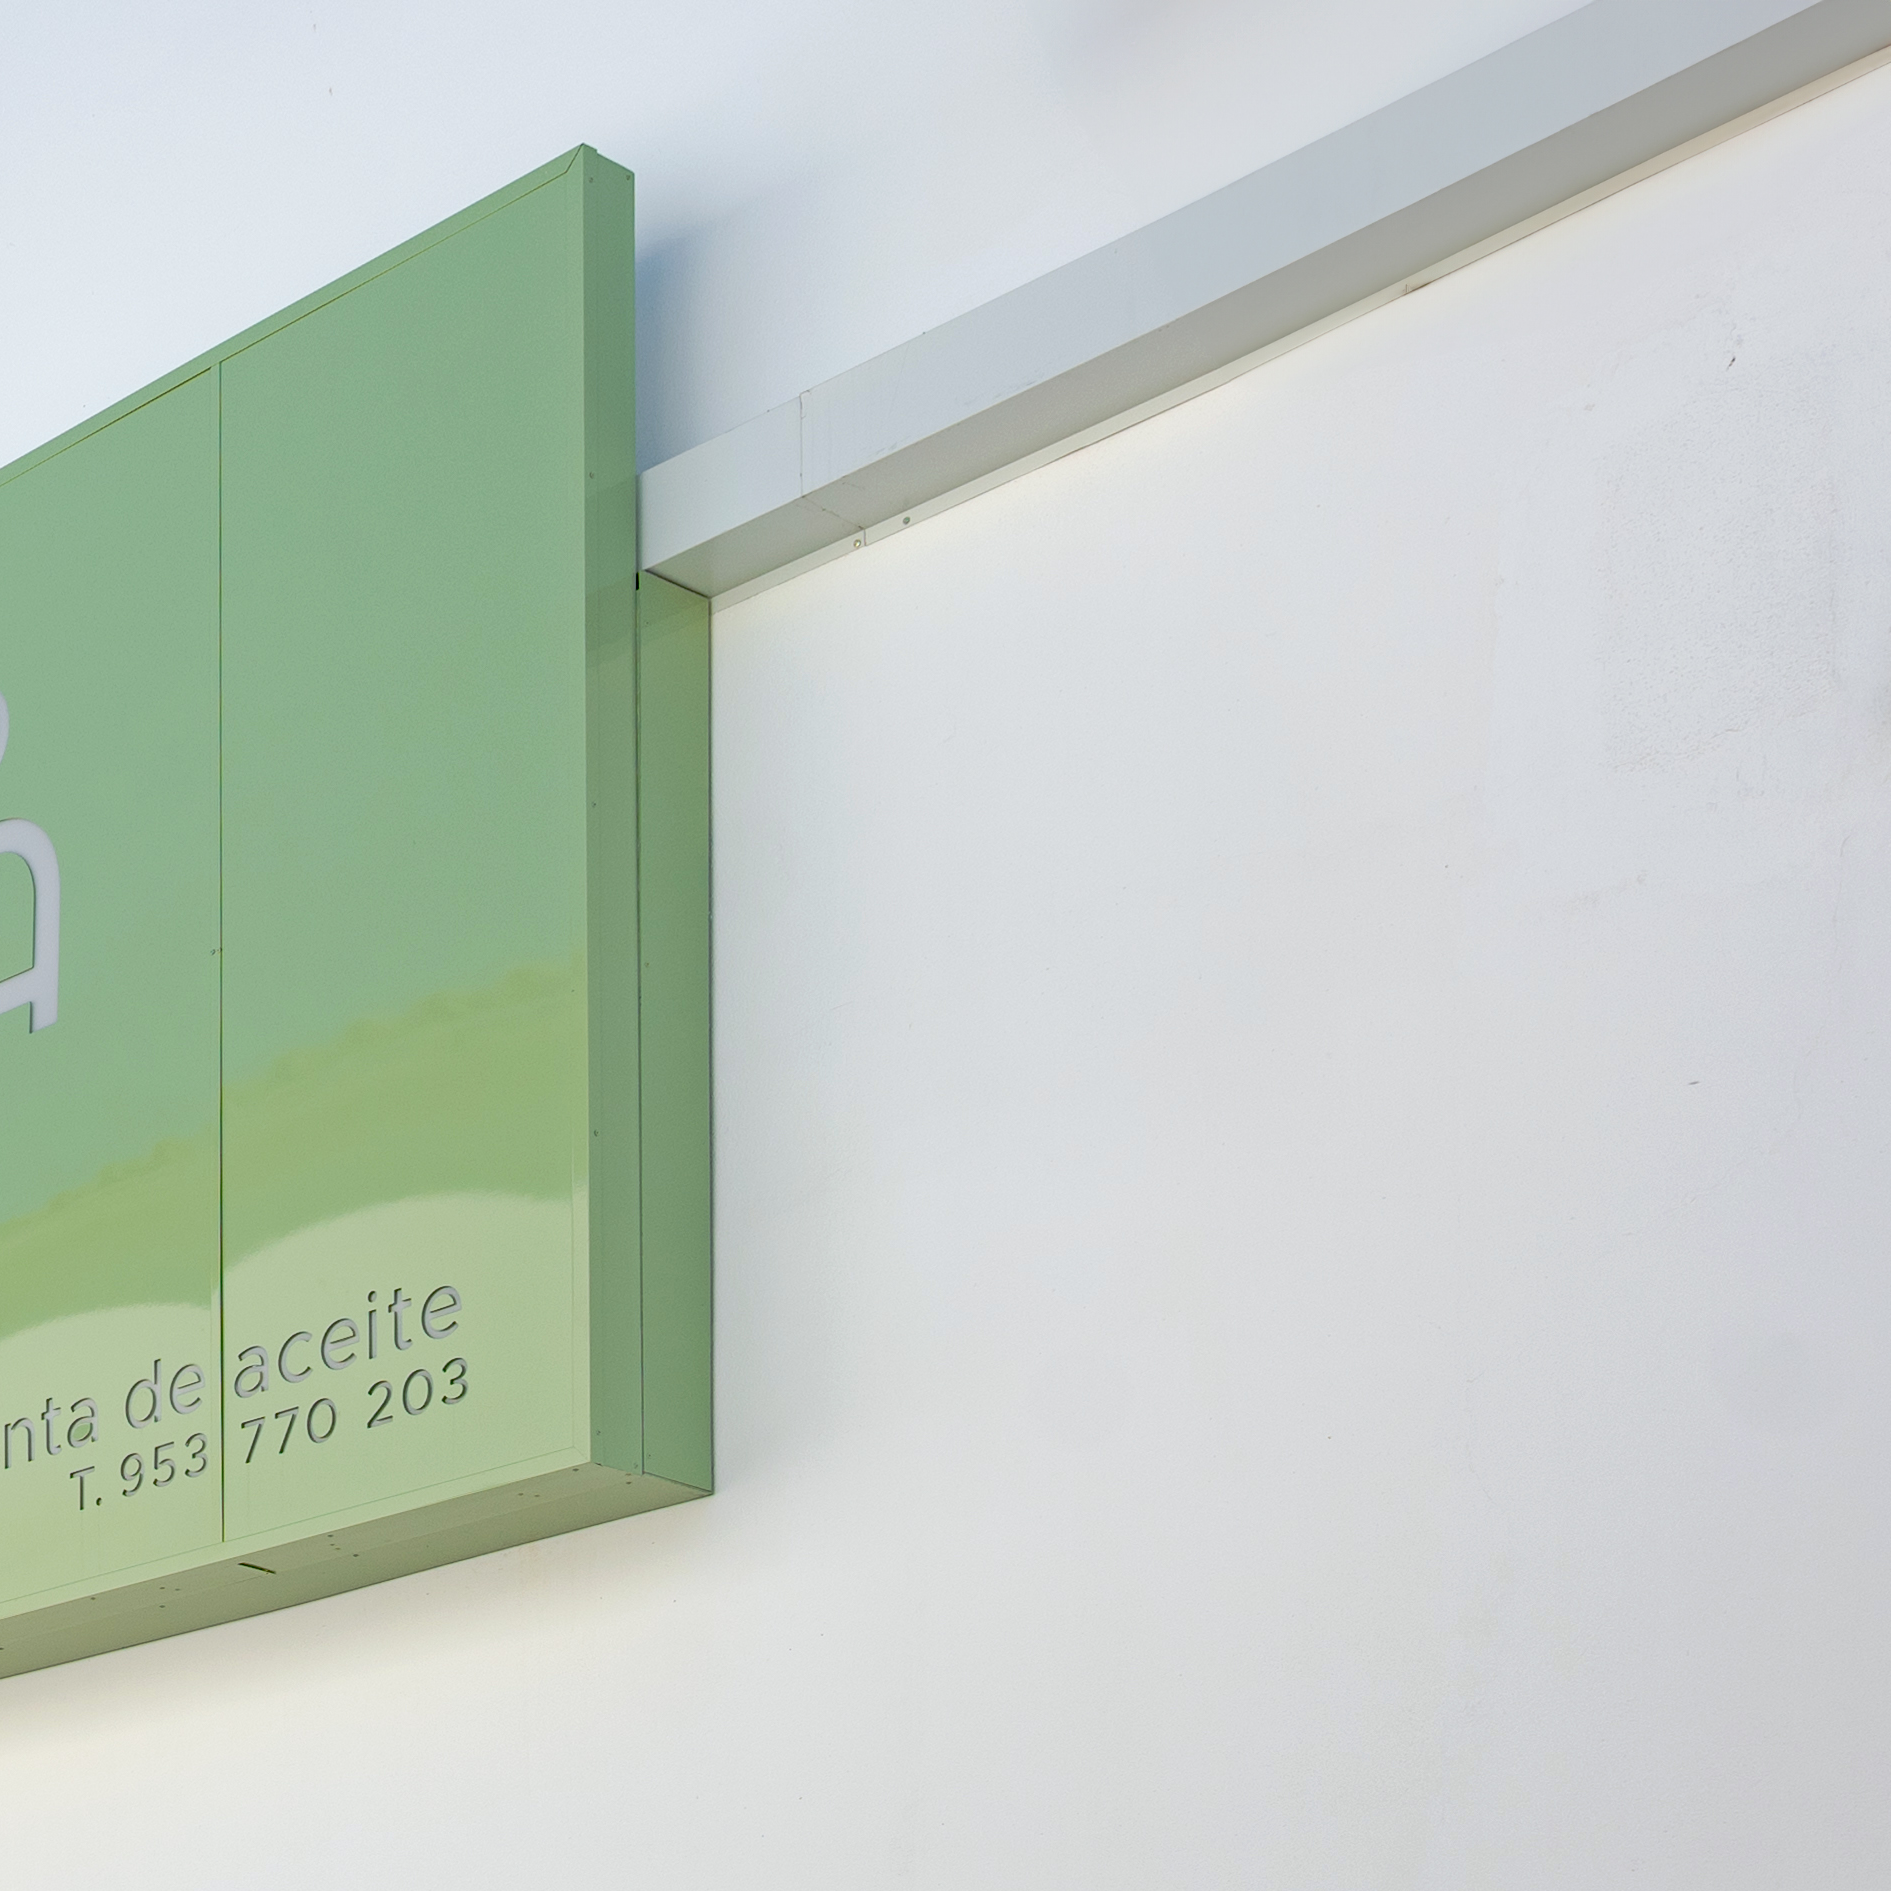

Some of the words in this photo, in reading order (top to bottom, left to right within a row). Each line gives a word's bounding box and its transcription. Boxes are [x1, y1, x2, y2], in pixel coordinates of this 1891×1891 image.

[124, 1357, 207, 1430] de
[233, 1284, 464, 1399] aceite
[68, 1464, 103, 1511] T.
[120, 1431, 209, 1498] 953
[240, 1396, 338, 1465] 770
[366, 1356, 470, 1429] 203
